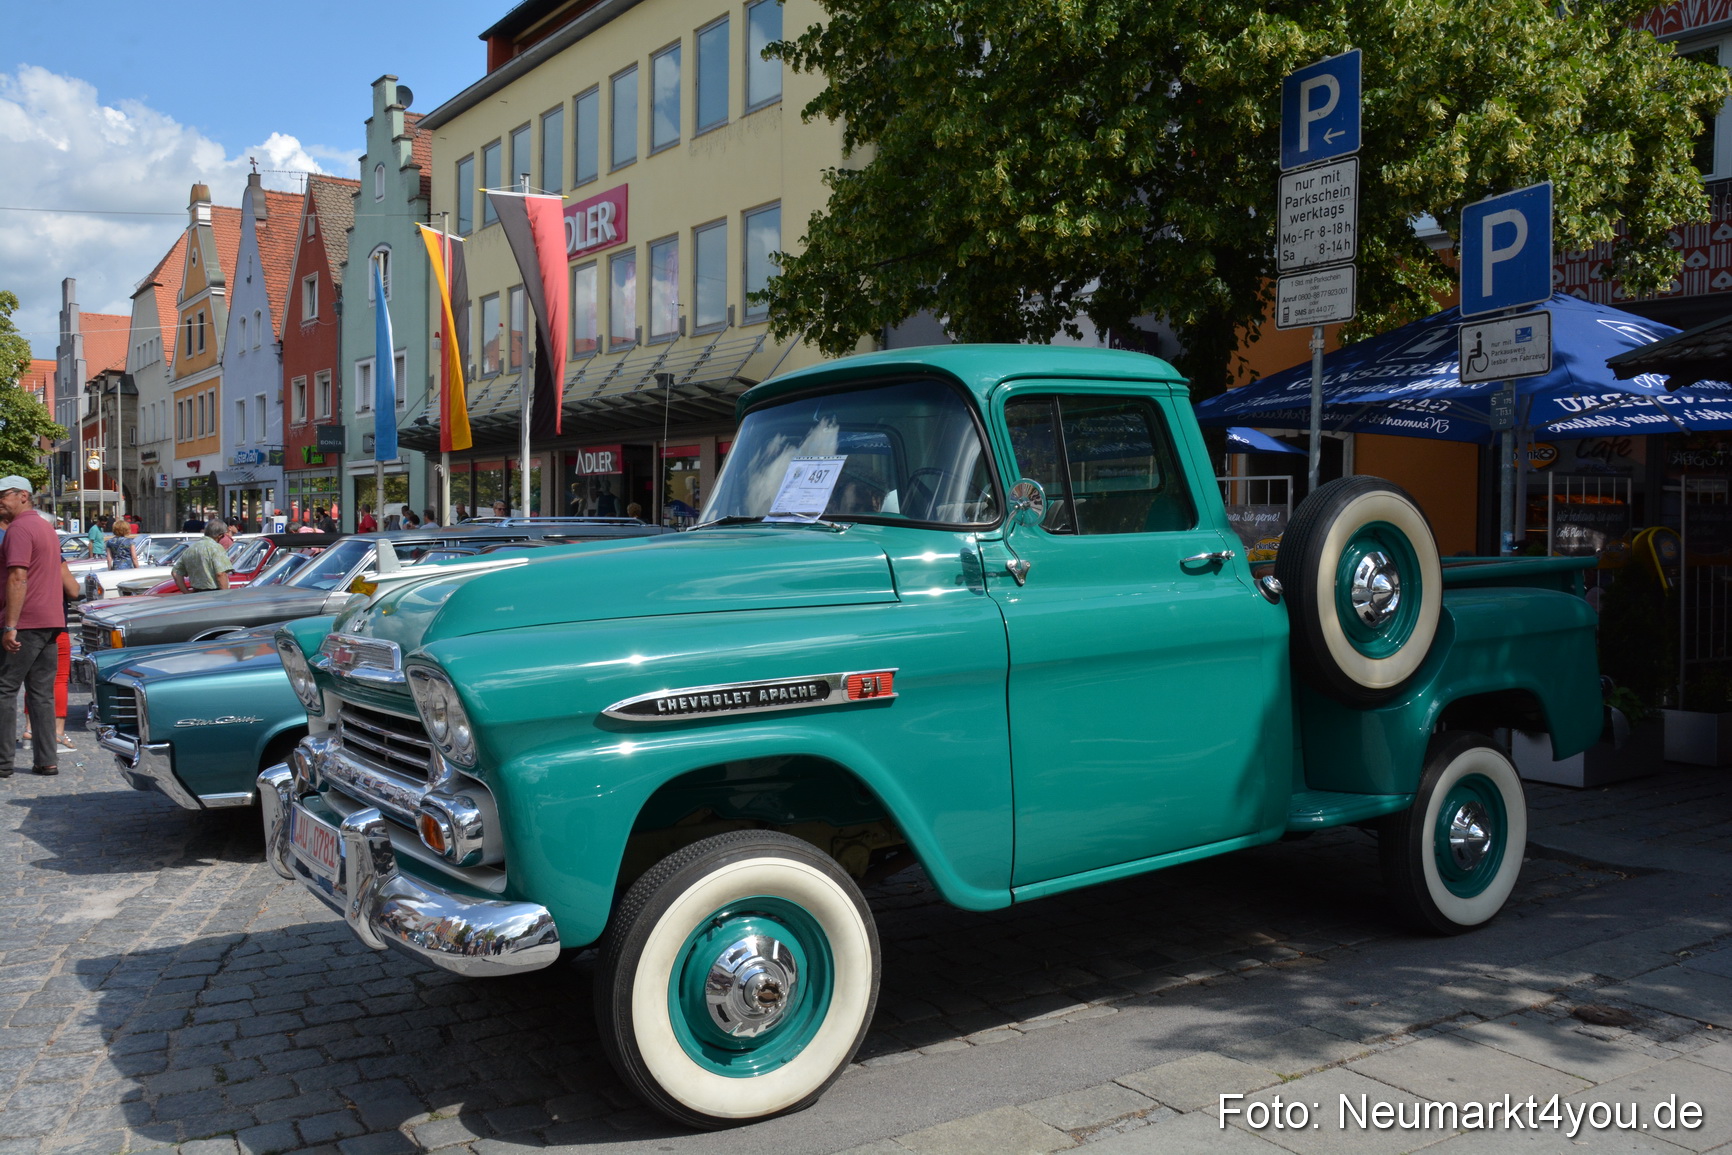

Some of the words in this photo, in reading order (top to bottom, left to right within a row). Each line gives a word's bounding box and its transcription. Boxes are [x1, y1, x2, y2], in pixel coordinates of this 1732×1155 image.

[1299, 73, 1341, 153] P
[1295, 178, 1315, 191] nur
[1321, 170, 1340, 185] mit
[1285, 185, 1350, 210] Parkschein
[1290, 204, 1345, 225] werktags
[564, 201, 617, 256] DLER
[1282, 249, 1295, 262] Sa
[1482, 208, 1529, 298] P
[1313, 273, 1341, 283] Parkschein
[1282, 295, 1297, 303] Anruf
[1294, 308, 1307, 317] SMS
[1490, 346, 1526, 356] Parkausweis
[1519, 353, 1546, 361] Fahrzeug
[575, 449, 613, 475] ADLER
[807, 469, 830, 484] 497
[1242, 511, 1254, 521] Sie
[1255, 512, 1280, 527] gerne!
[277, 524, 283, 533] P
[861, 676, 883, 694] 31
[657, 691, 751, 712] CHEVROLET
[759, 684, 818, 702] APACHE
